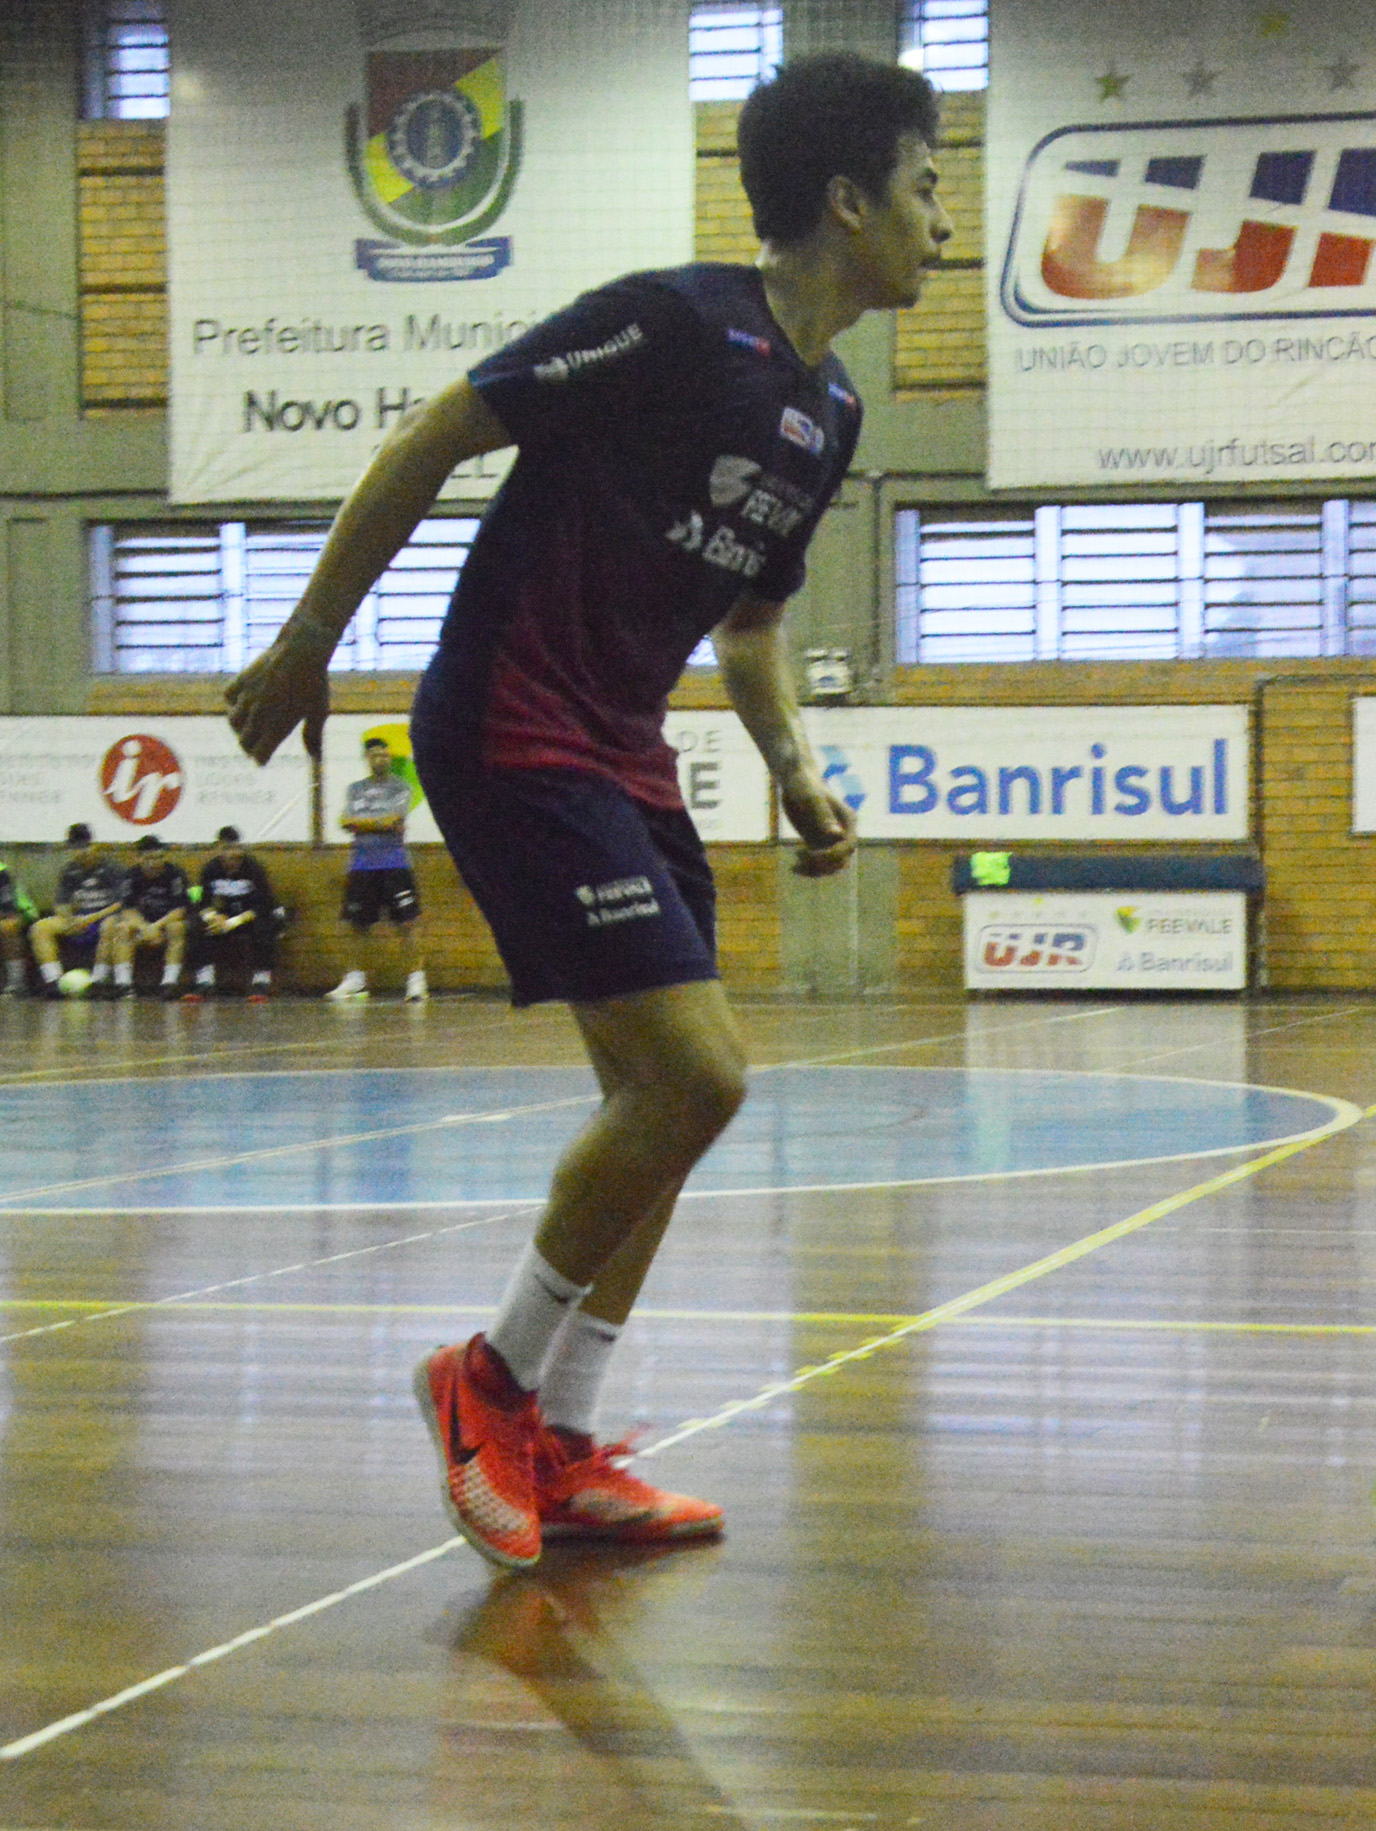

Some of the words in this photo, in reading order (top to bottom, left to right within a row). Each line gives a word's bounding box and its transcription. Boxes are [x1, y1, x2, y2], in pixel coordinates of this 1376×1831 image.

[192, 316, 391, 356] Prefeitura
[1015, 342, 1107, 373] UNIÃO
[1117, 339, 1216, 369] JOVEM
[1224, 337, 1268, 365] DO
[241, 388, 362, 434] Novo
[887, 738, 1229, 817] Banrisul
[1148, 917, 1233, 935] FEEVALE
[1139, 951, 1234, 973] Banrisul
